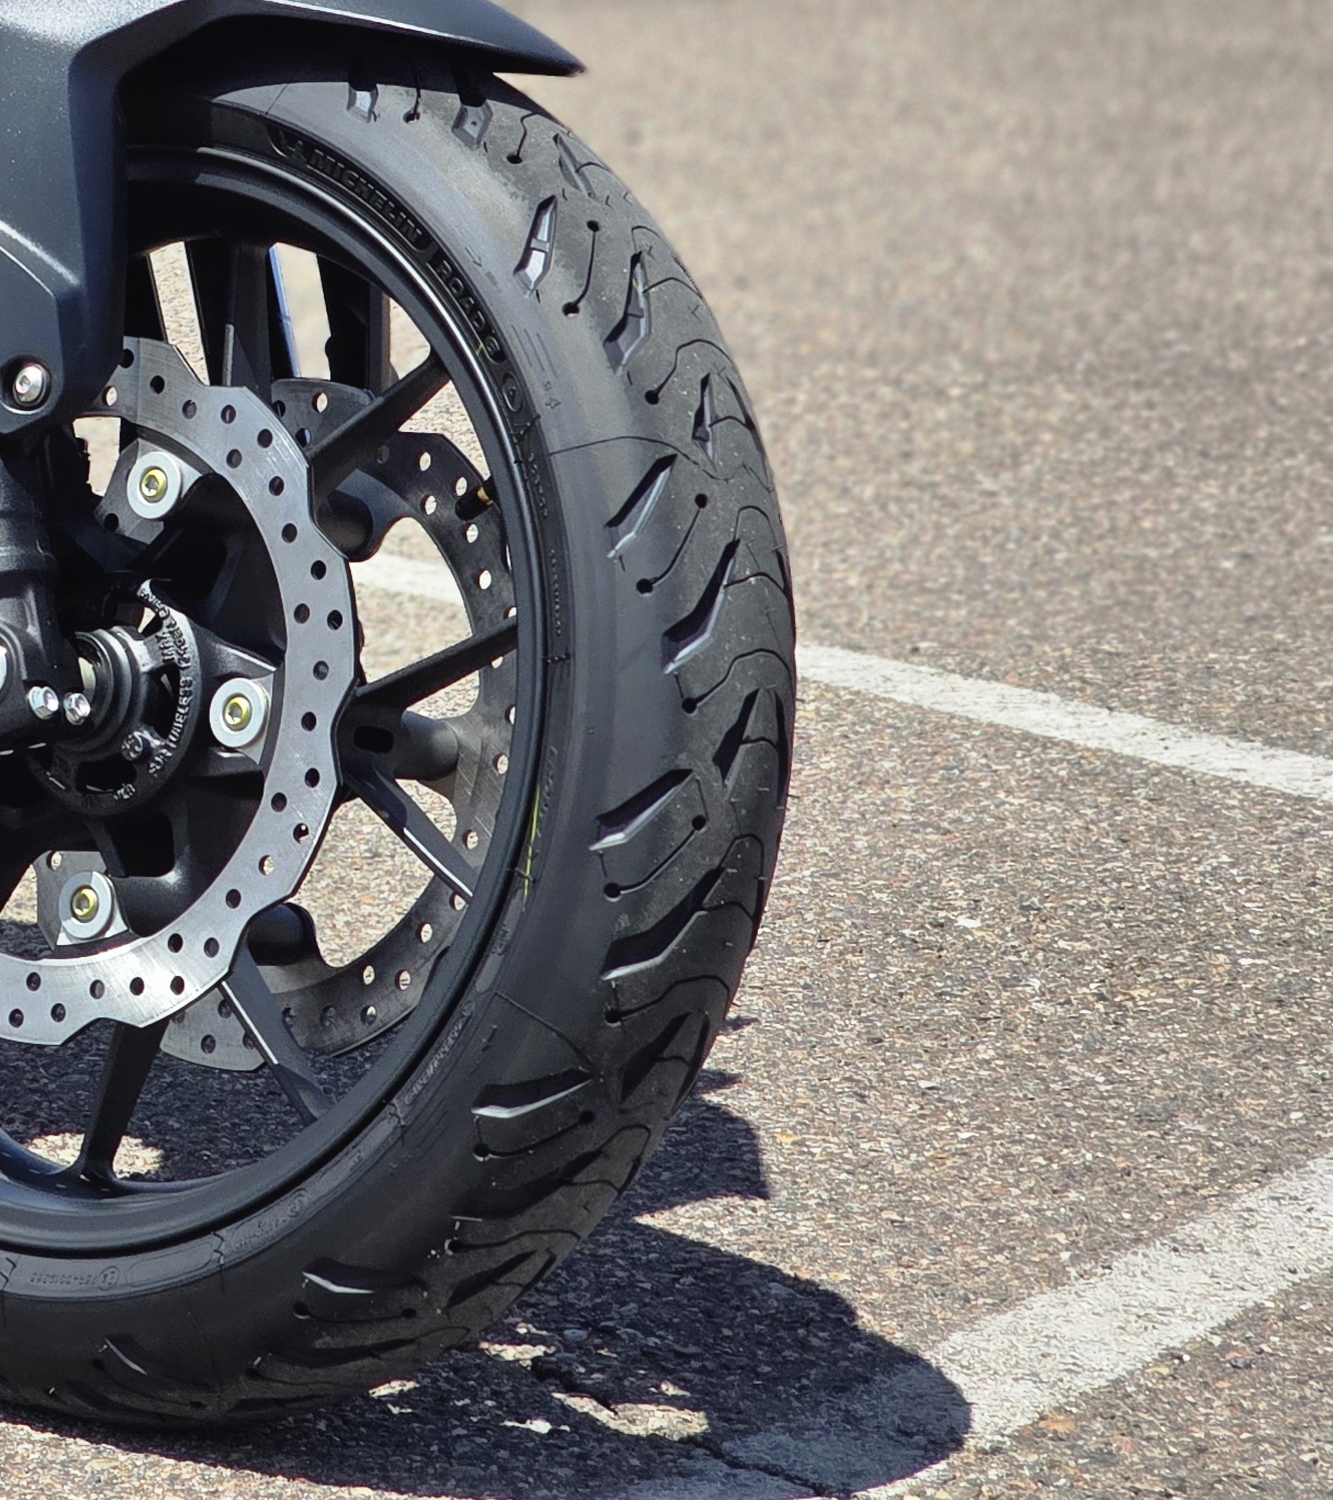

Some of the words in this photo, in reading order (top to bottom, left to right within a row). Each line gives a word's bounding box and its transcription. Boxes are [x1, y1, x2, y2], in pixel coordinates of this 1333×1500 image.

[309, 148, 424, 245] MICHELIN
[434, 259, 487, 331] ROAD
[484, 334, 502, 355] 6
